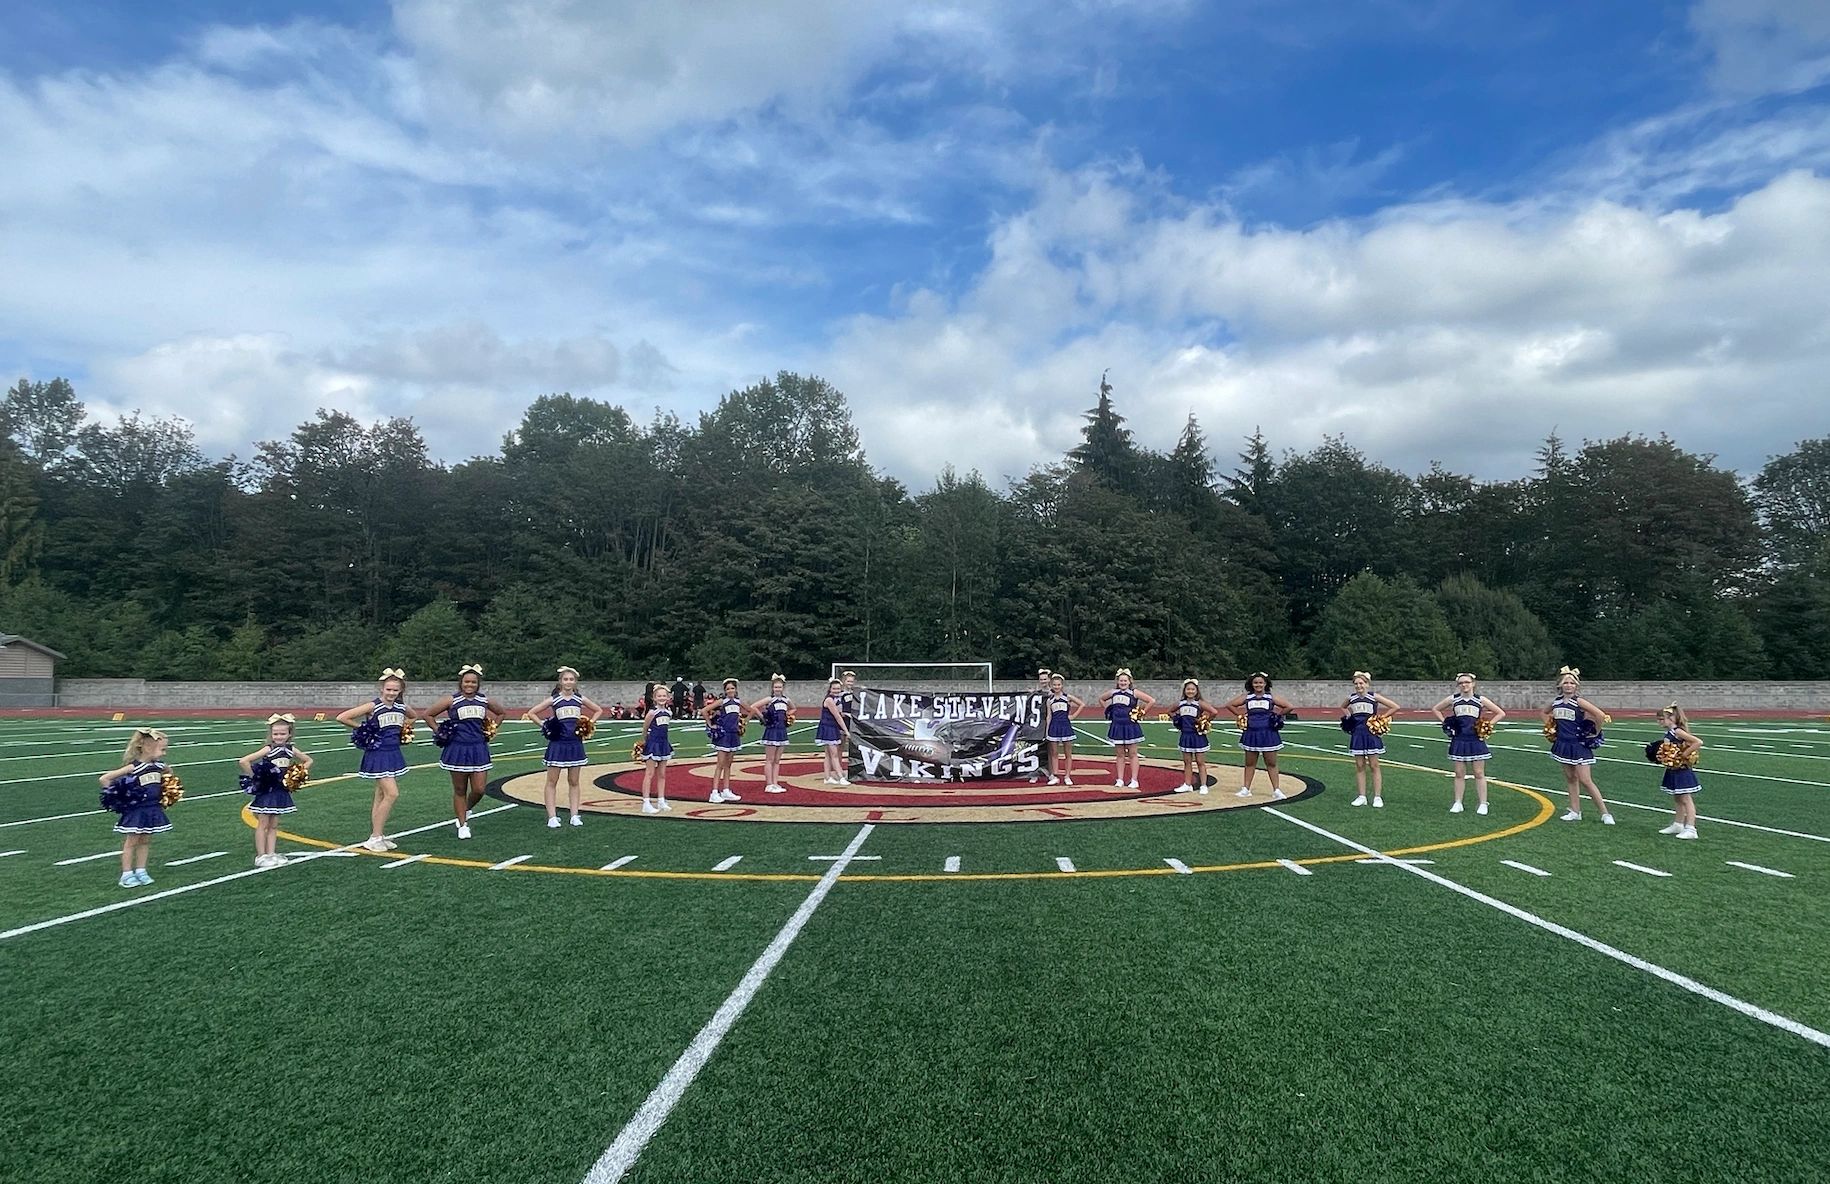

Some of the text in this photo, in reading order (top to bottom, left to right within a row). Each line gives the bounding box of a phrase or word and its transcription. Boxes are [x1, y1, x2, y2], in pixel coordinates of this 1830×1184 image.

[858, 692, 1043, 728] LAKE STEVENS
[858, 744, 1040, 779] VIKINGS
